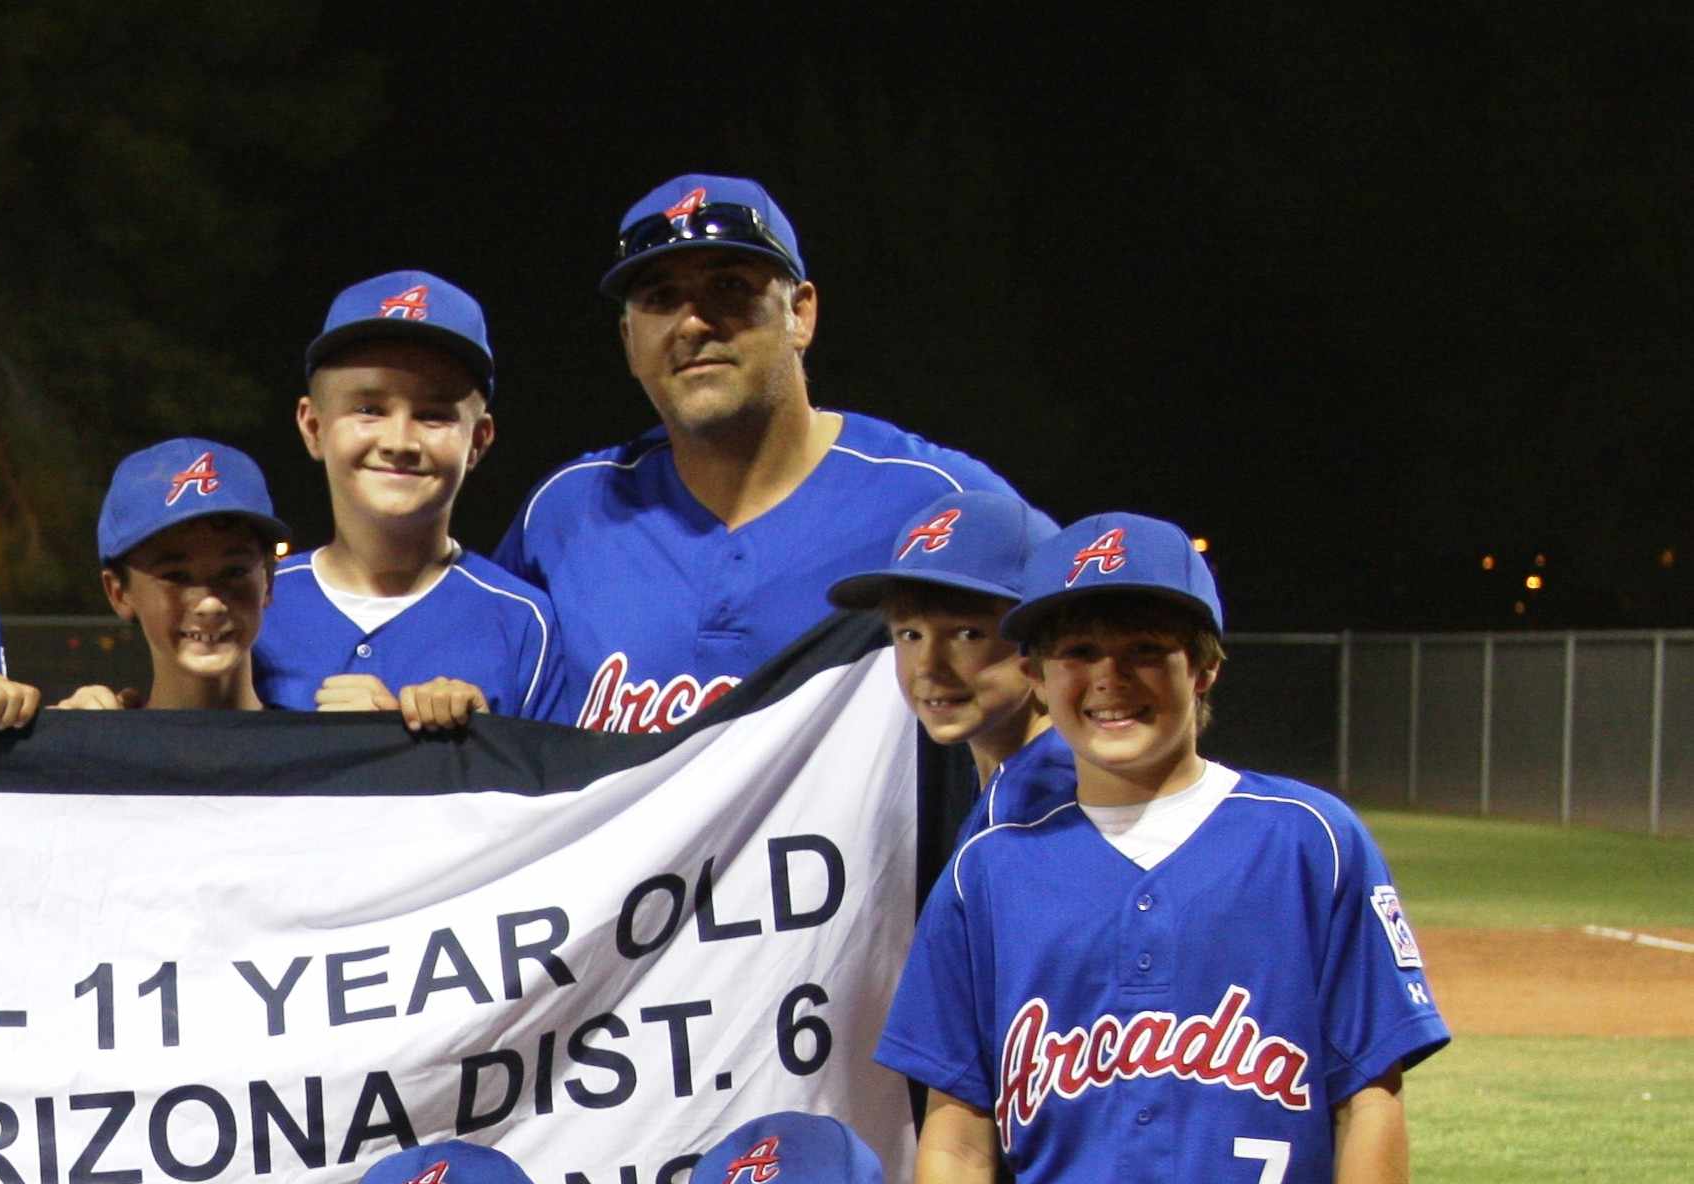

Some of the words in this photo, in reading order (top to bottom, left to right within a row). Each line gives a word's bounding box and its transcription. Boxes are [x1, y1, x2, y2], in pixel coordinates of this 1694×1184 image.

[376, 284, 429, 321] A
[165, 452, 220, 507] A
[898, 508, 962, 560] A
[1064, 528, 1127, 588] A
[74, 960, 180, 1050] 11
[232, 905, 577, 1037] YEAR
[615, 833, 846, 960] OLD
[455, 1000, 733, 1137] DIST.
[776, 983, 832, 1076] 6
[996, 985, 1311, 1153] Arcadia
